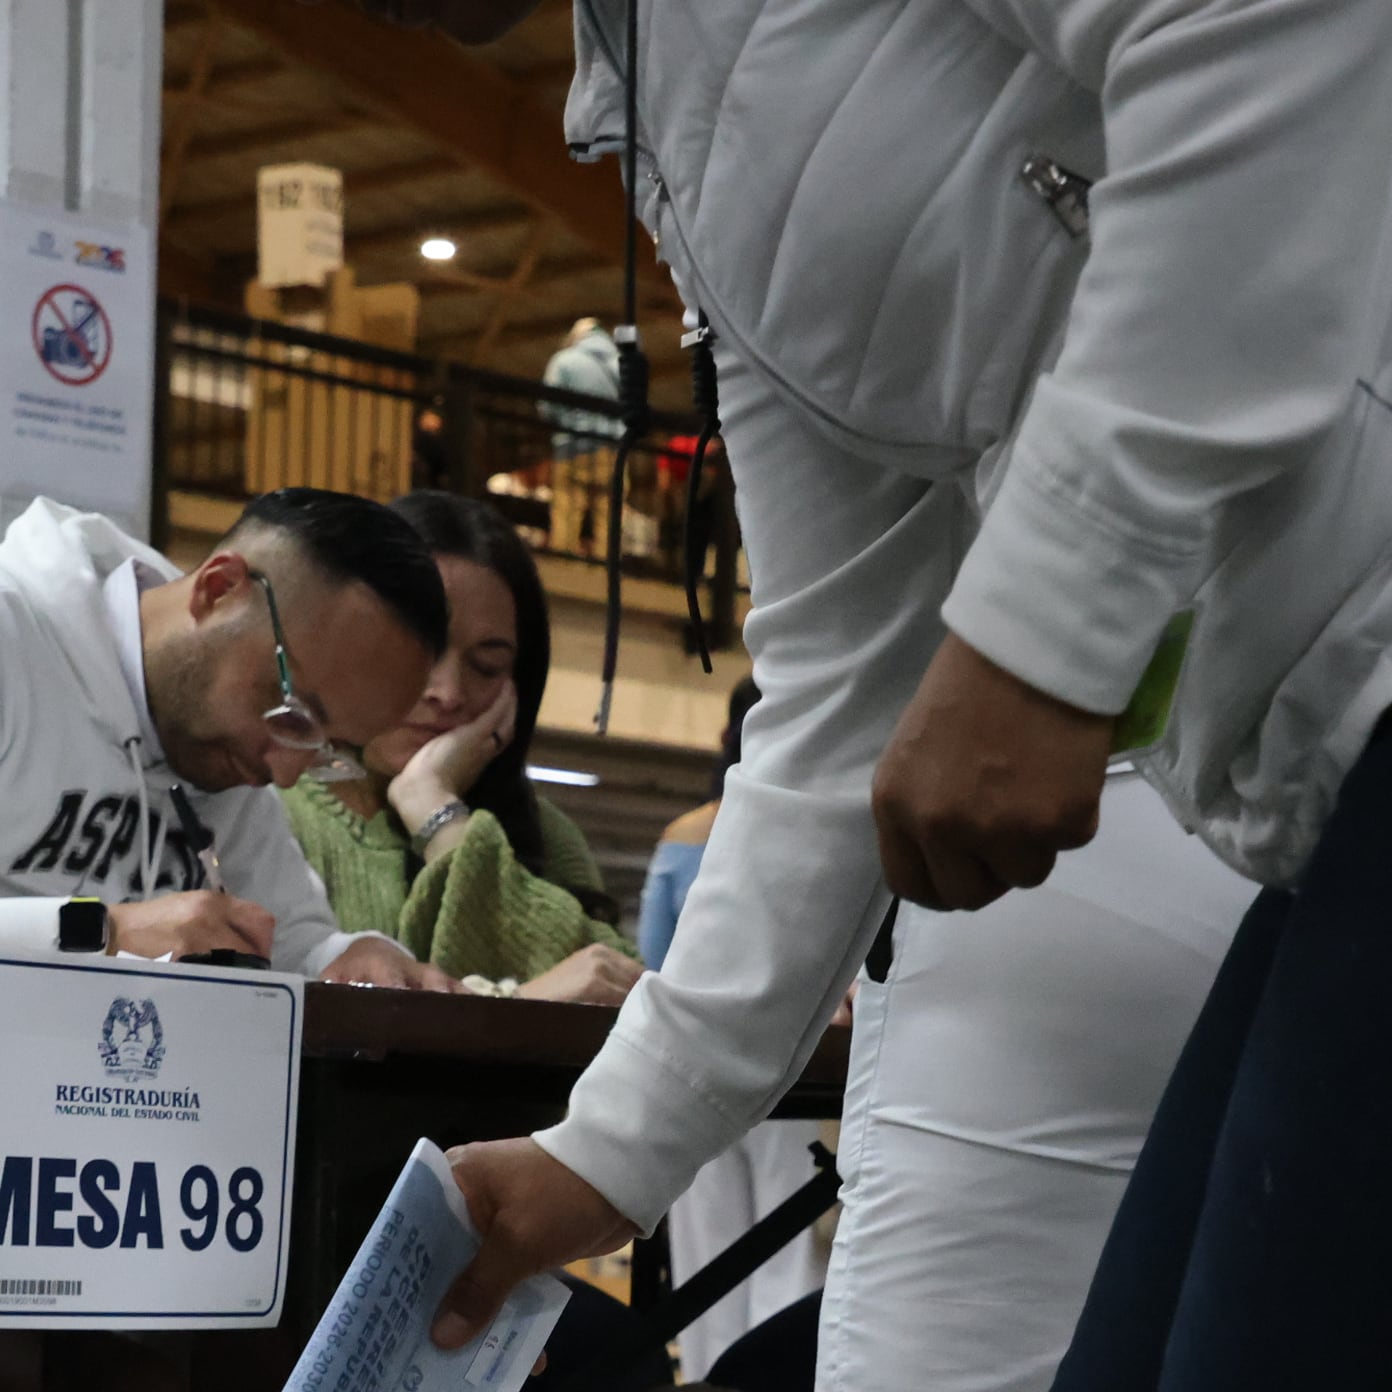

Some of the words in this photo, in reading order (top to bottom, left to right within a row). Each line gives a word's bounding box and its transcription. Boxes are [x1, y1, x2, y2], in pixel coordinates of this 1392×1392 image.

[55, 1104, 107, 1117] NACIONAL
[111, 1107, 130, 1118] DEL
[134, 1109, 173, 1120] ESTADO
[175, 1110, 200, 1122] CIVIL
[56, 1084, 201, 1109] REGISTRADURÍA
[180, 1165, 264, 1252] 98
[350, 1208, 405, 1299] PERIODO
[397, 1226, 420, 1261] DE
[378, 1265, 403, 1299] LA
